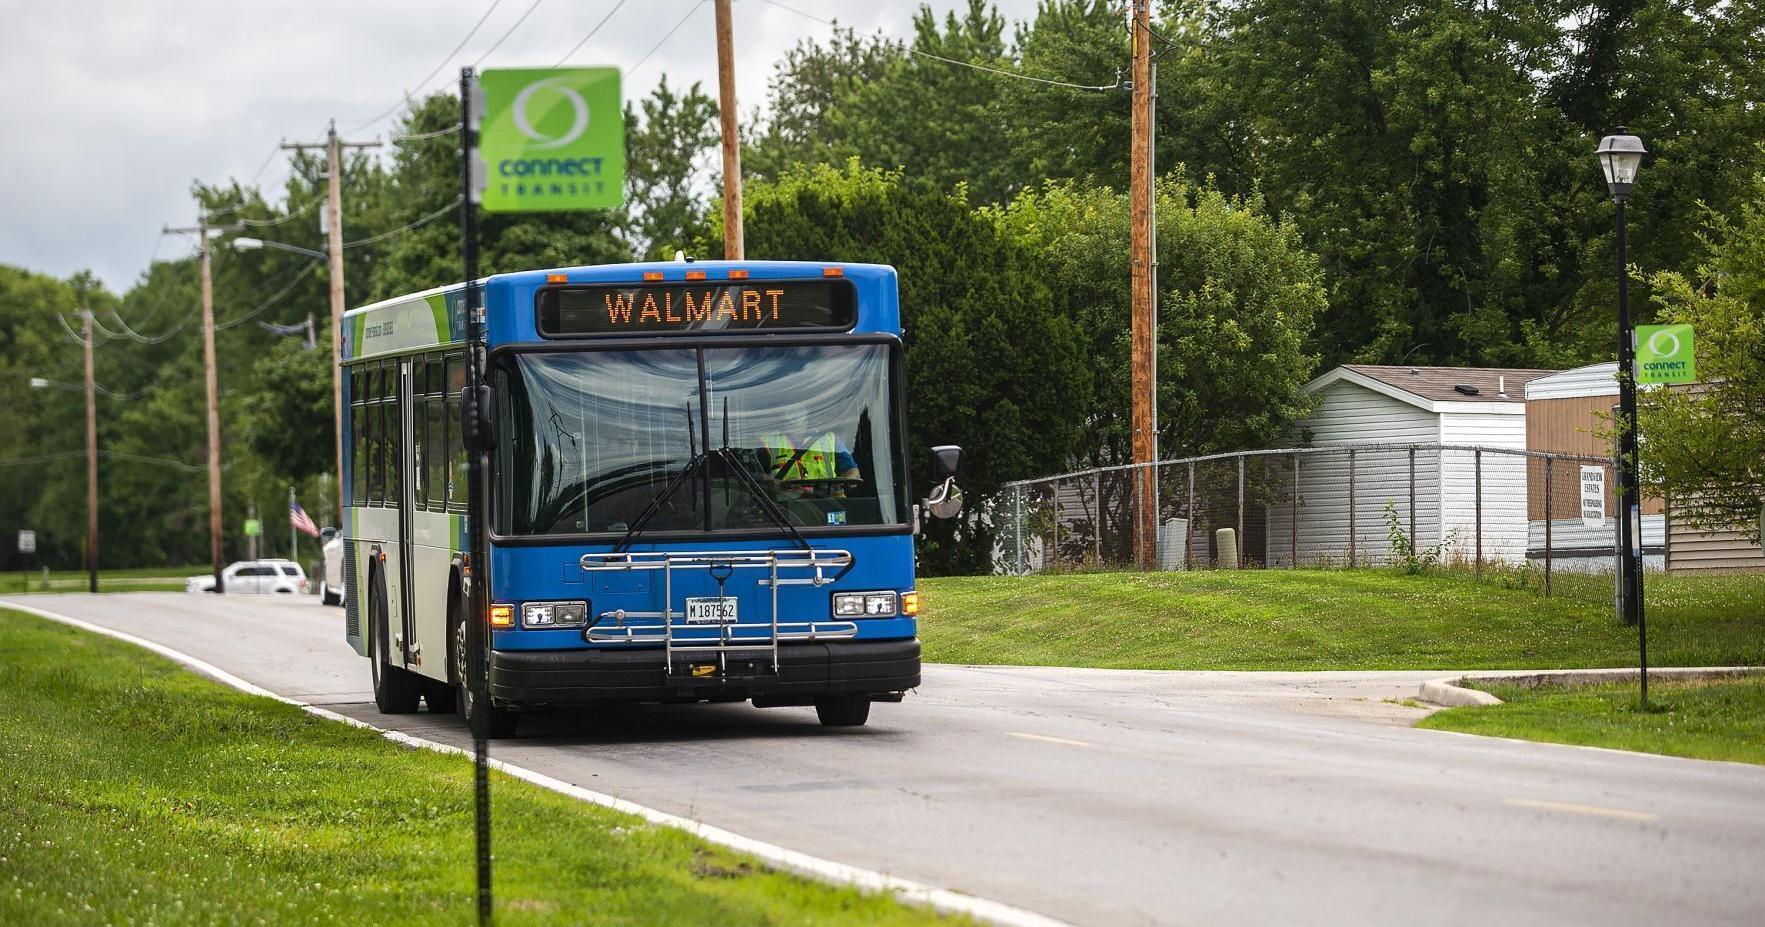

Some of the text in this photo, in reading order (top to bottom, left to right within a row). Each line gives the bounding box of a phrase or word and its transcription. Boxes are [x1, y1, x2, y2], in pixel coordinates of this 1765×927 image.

[502, 182, 603, 196] TRANSIT
[606, 289, 784, 323] WALMART
[699, 605, 734, 617] 187562
